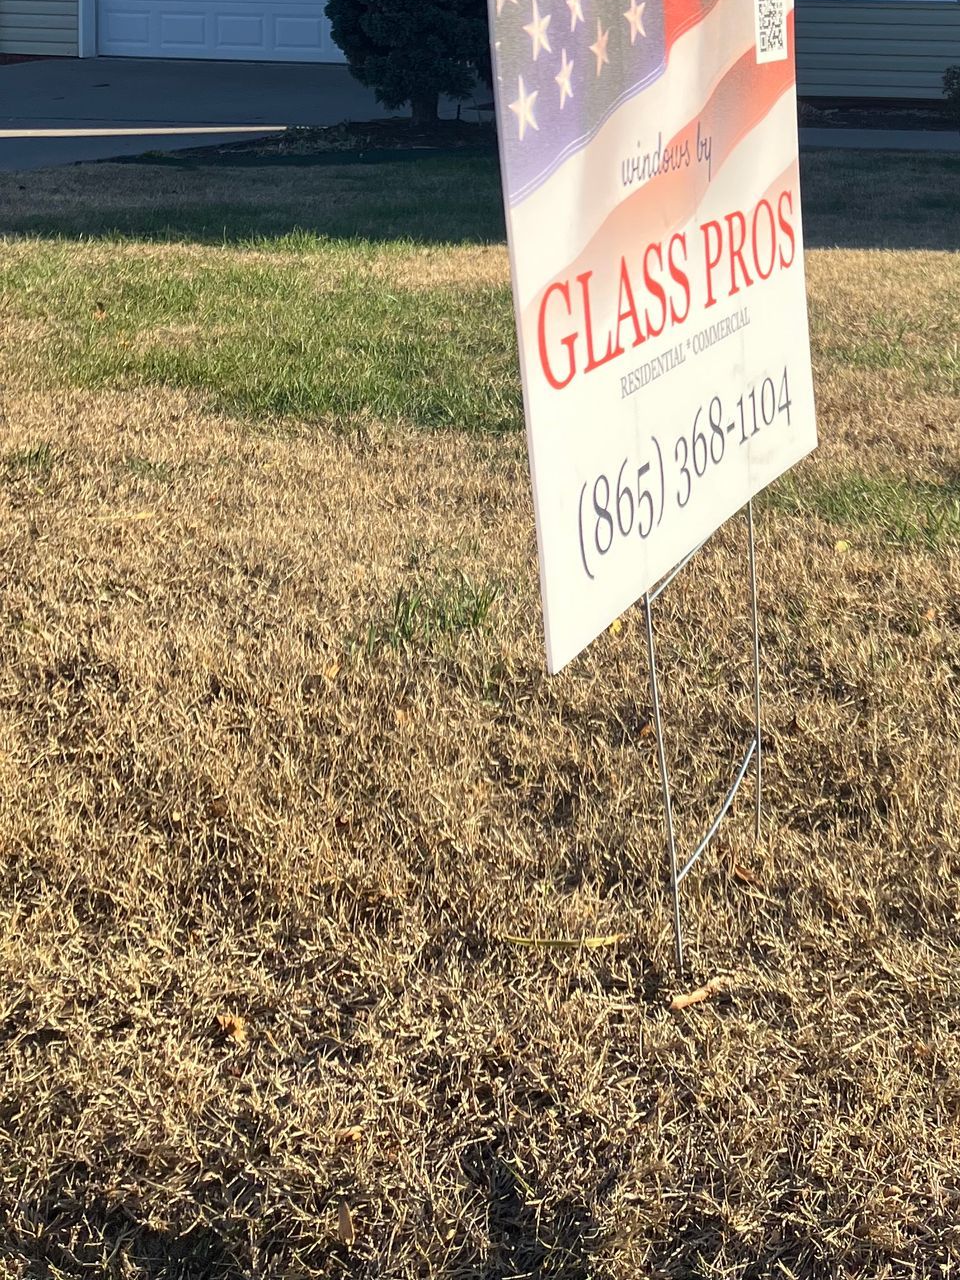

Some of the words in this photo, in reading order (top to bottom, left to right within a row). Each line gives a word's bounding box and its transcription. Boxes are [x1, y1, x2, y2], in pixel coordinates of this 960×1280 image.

[621, 131, 691, 187] windows
[696, 120, 712, 183] by
[537, 231, 691, 390] GLASS
[699, 190, 795, 309] PROS
[619, 343, 686, 400] RESIDENTIAL
[692, 307, 751, 355] COMMERCIAL
[578, 435, 665, 580] (865)
[674, 364, 792, 509] 368-1104
